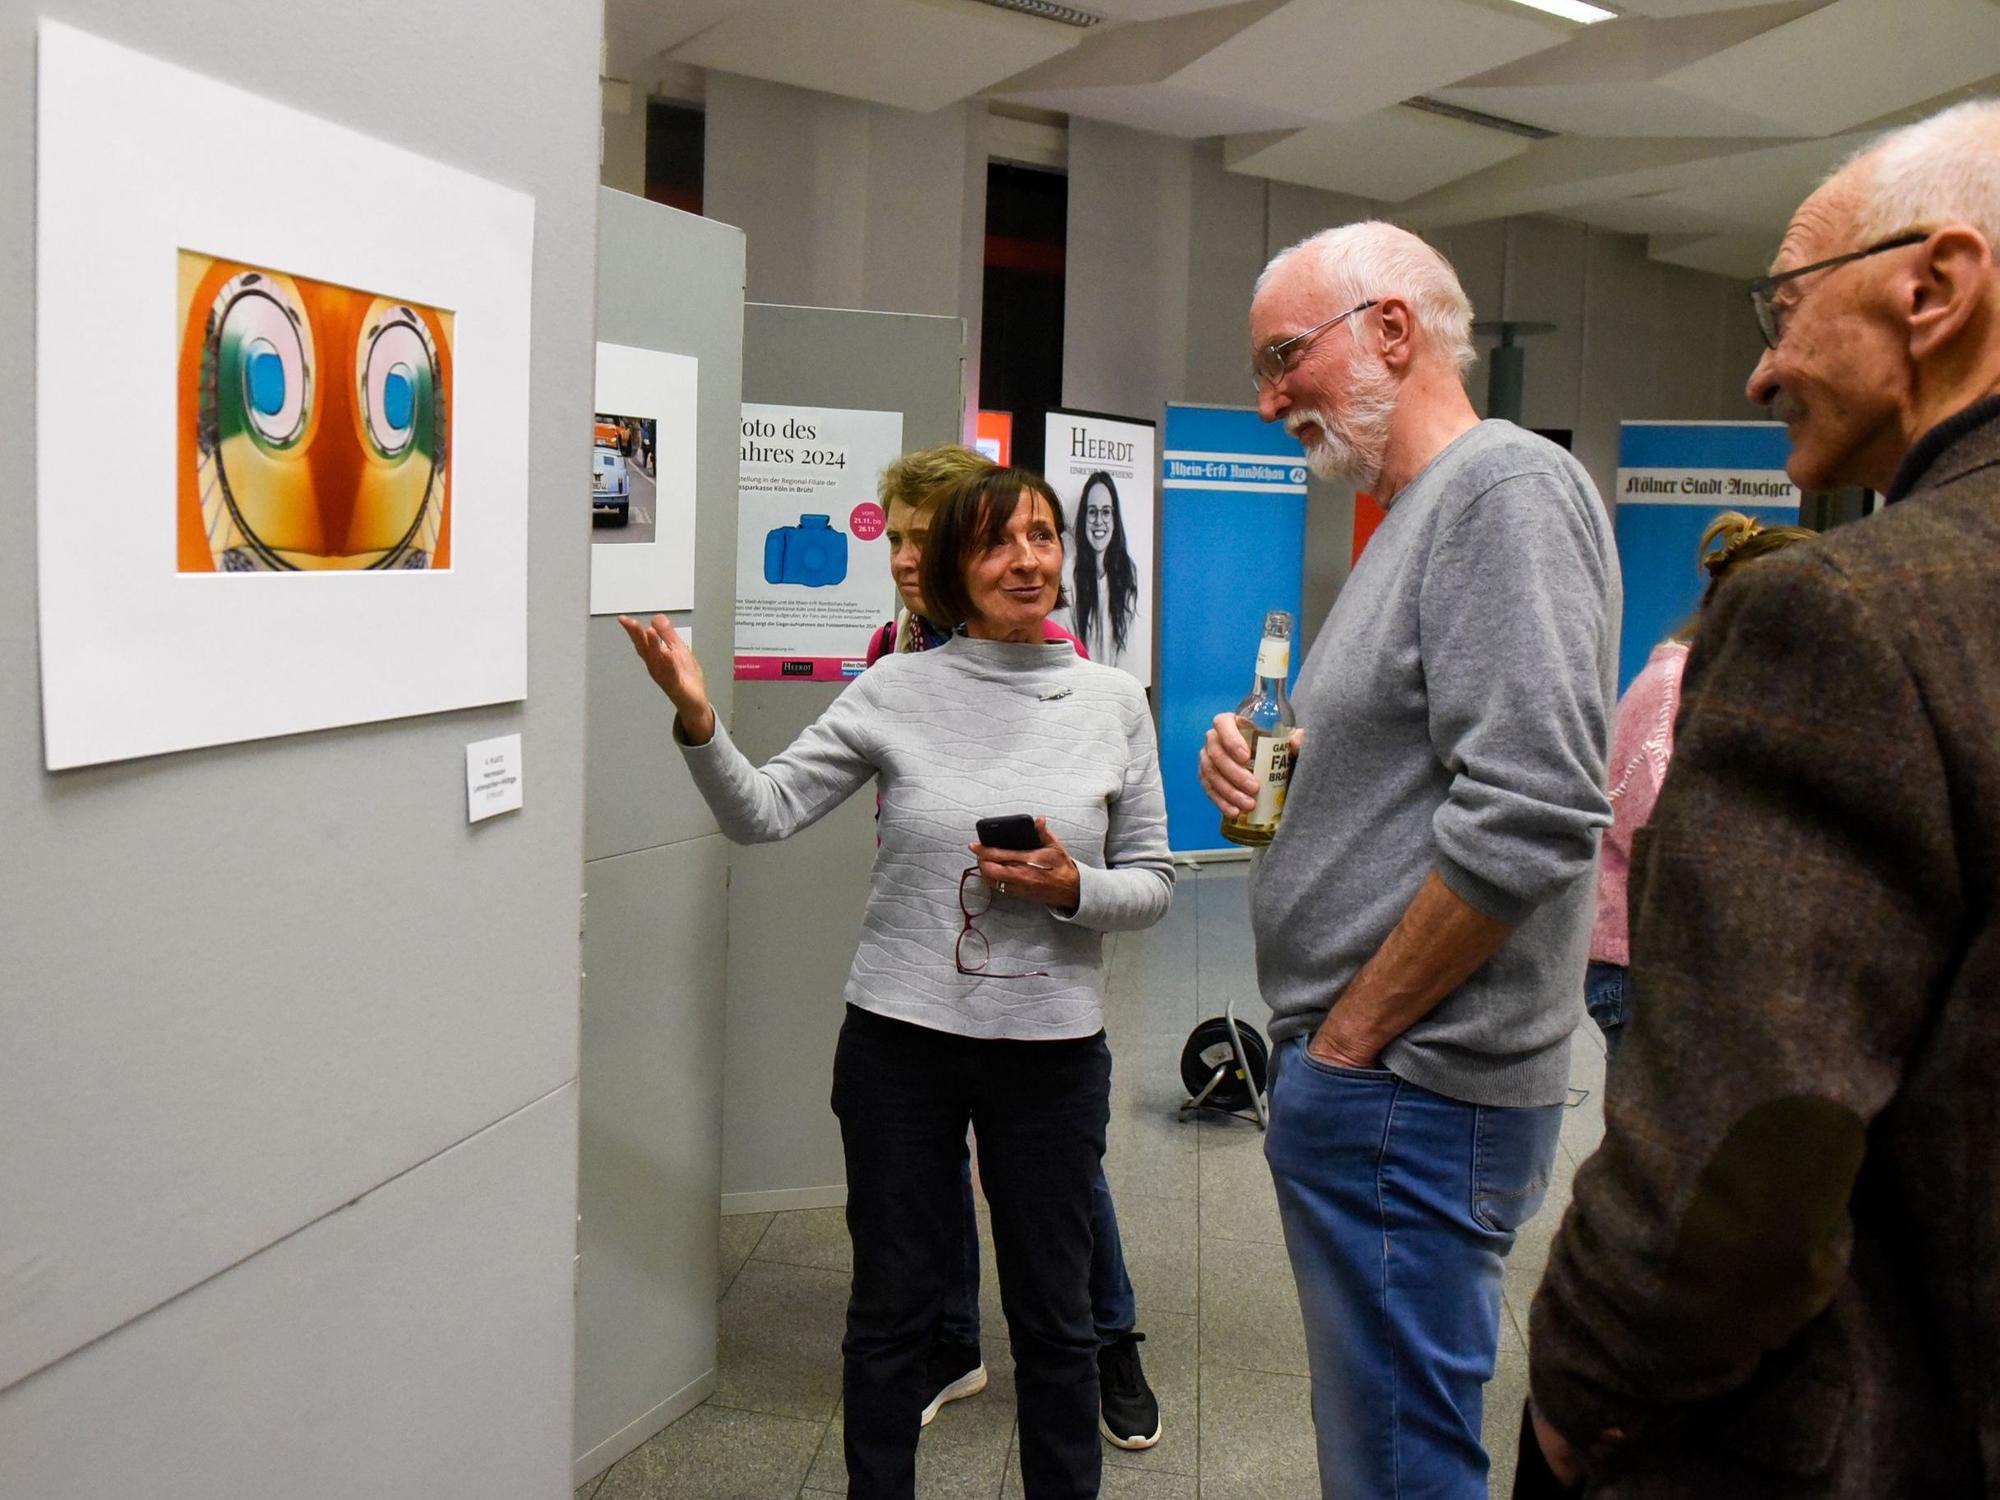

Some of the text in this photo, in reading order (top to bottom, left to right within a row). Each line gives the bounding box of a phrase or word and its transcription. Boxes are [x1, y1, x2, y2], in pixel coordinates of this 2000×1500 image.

[740, 417, 817, 440] oto des
[740, 441, 846, 469] ahres 2024
[1071, 427, 1134, 463] HEERDT
[1170, 461, 1227, 478] Rhein-Erft
[1626, 477, 1678, 493] Kölner
[1271, 754, 1290, 770] FA
